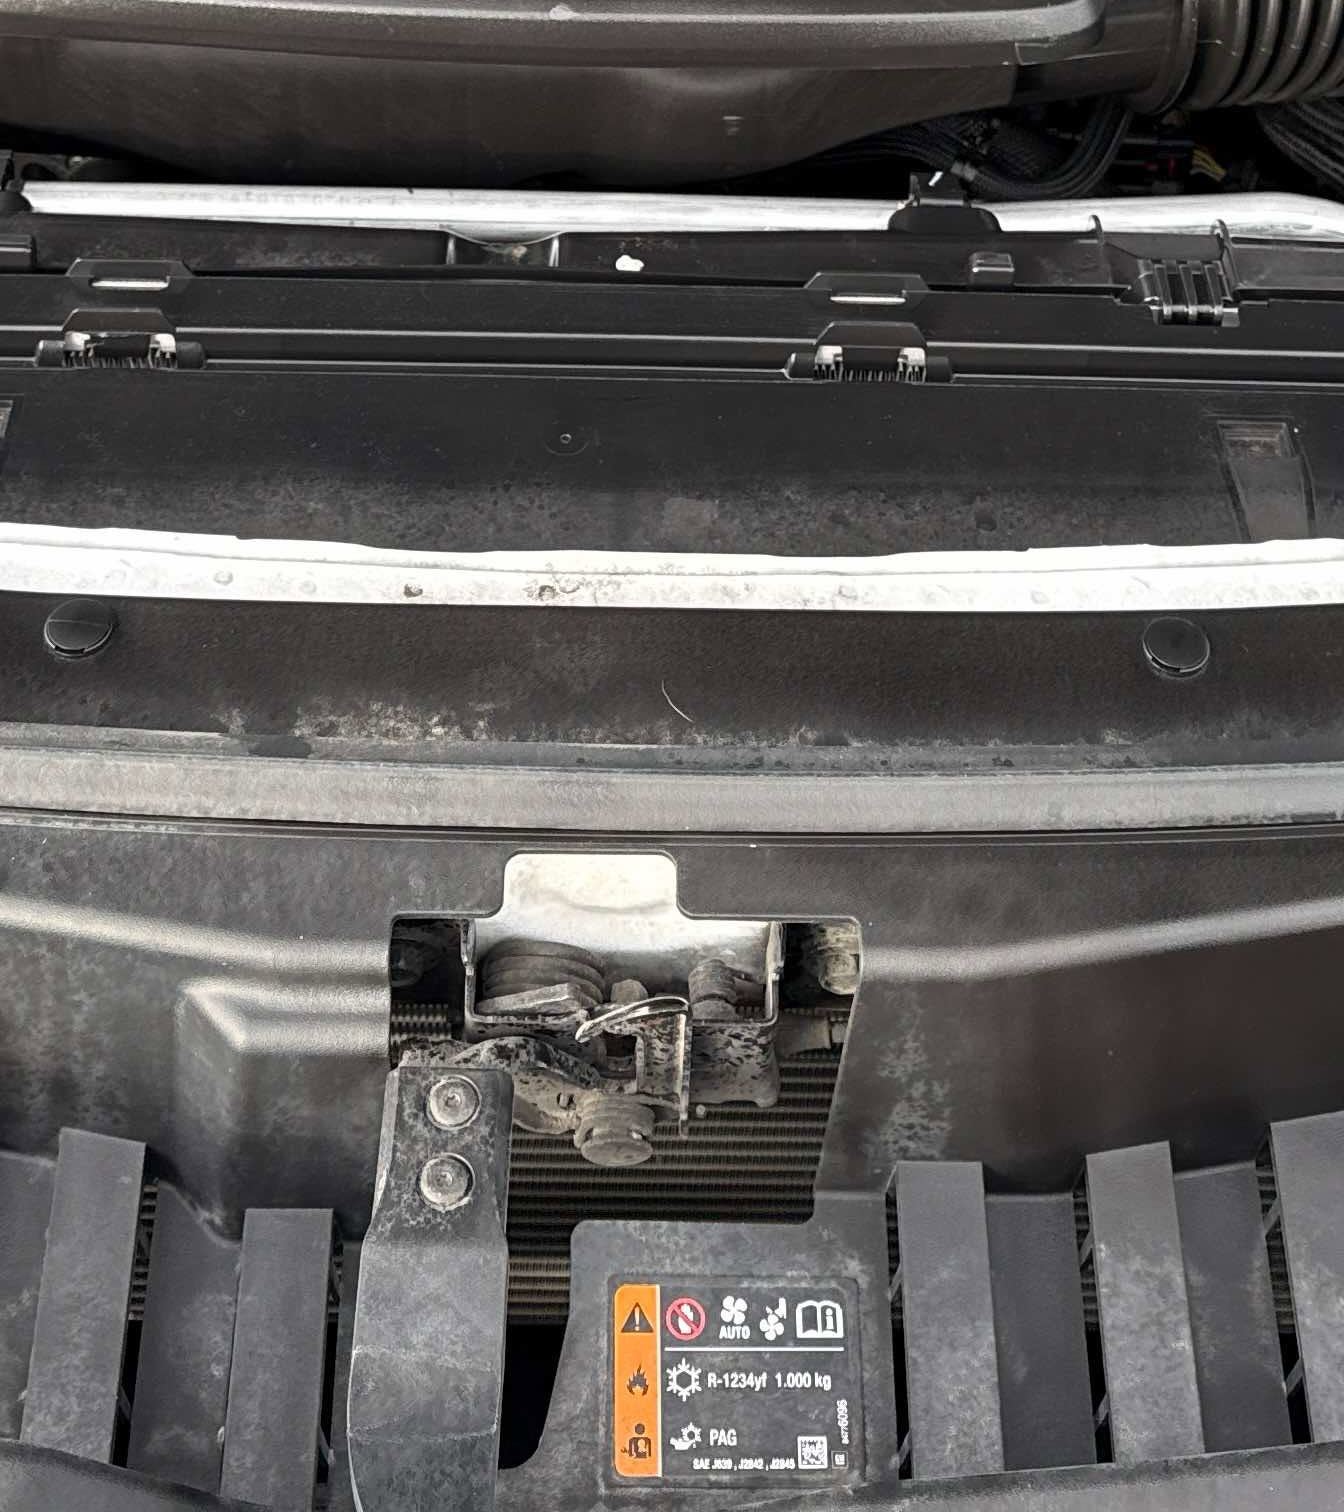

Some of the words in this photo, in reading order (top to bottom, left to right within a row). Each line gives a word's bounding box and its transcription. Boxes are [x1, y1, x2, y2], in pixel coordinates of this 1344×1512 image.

[719, 1325, 750, 1339] AUTO
[707, 1372, 767, 1391] R-1234yf
[775, 1372, 811, 1388] 1.000
[814, 1372, 832, 1391] kg
[709, 1428, 737, 1446] PAG
[692, 1458, 710, 1470] SAE
